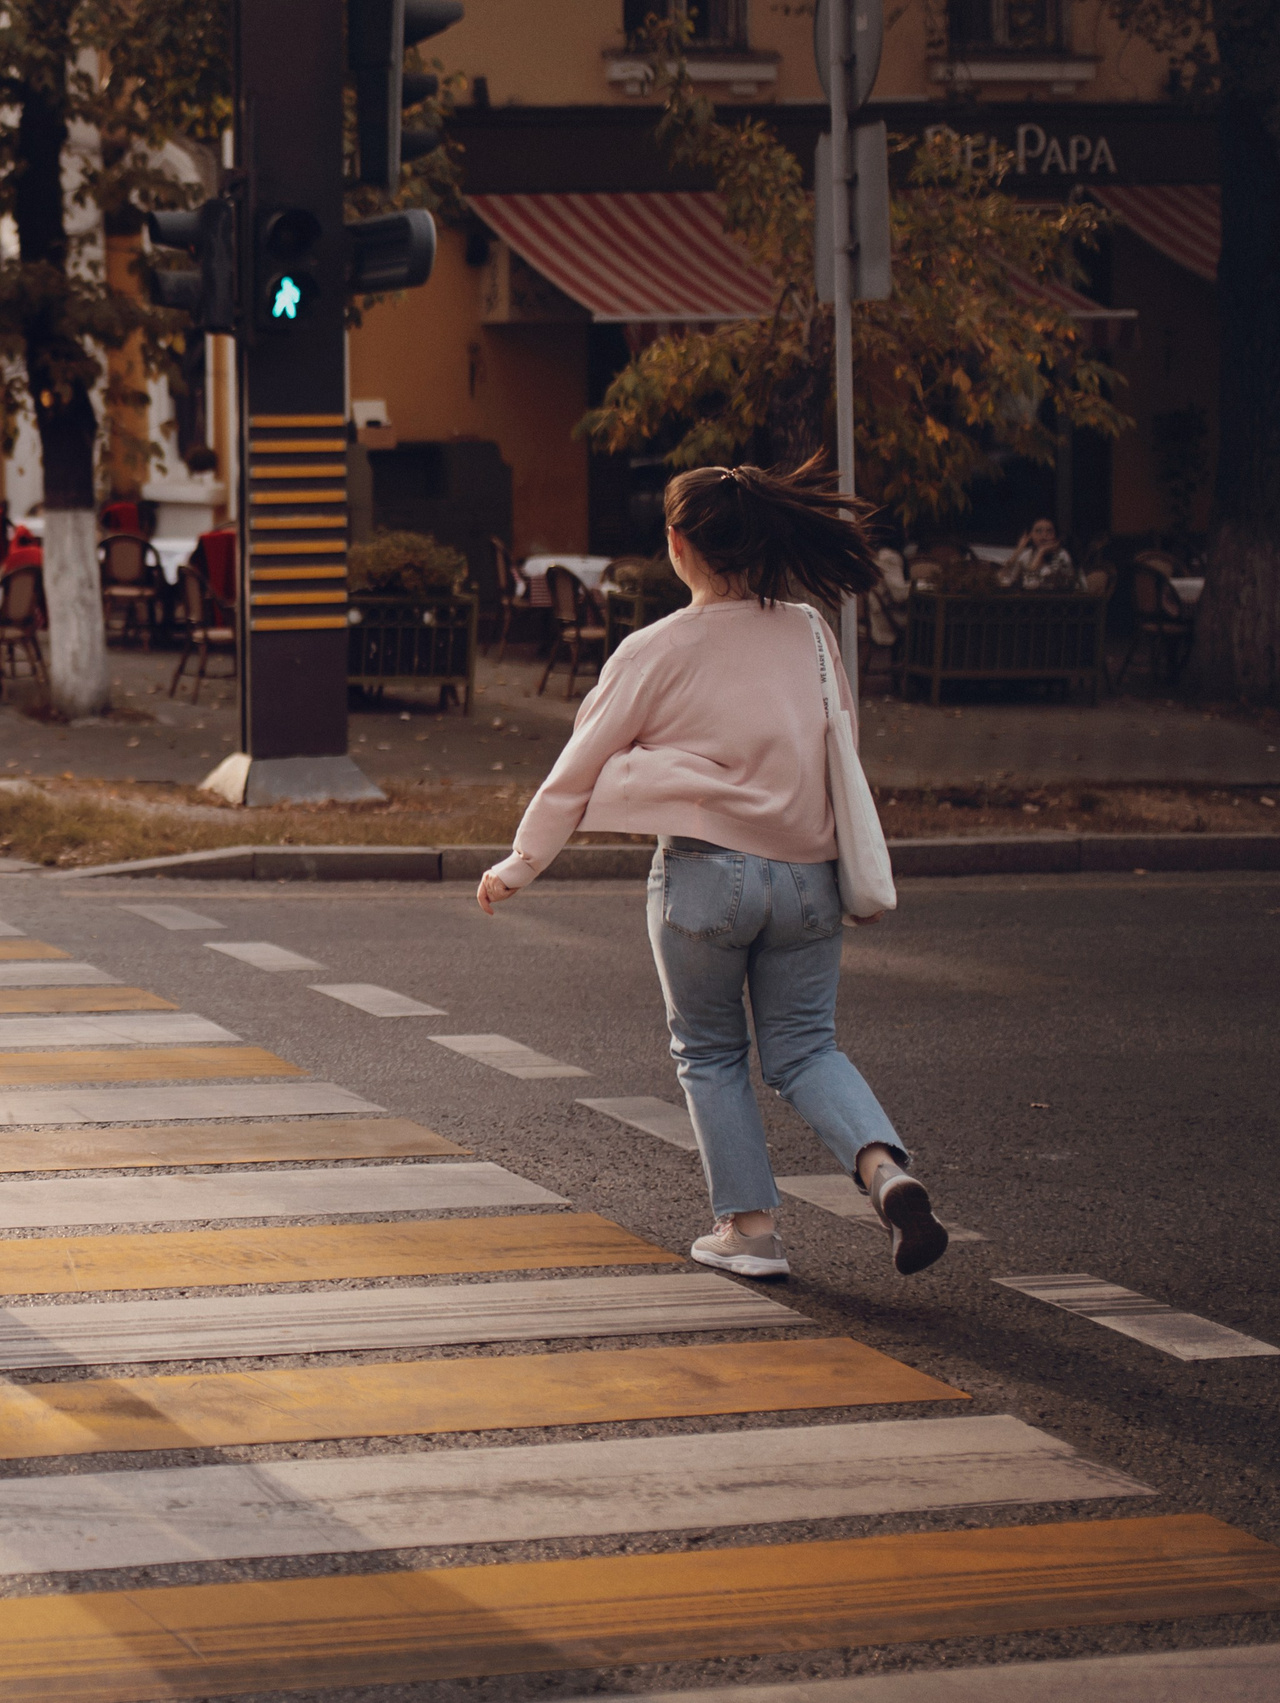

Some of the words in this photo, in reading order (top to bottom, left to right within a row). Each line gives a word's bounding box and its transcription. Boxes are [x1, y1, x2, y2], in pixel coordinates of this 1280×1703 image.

[1017, 123, 1117, 174] PAPA
[815, 631, 824, 652] BEARS
[820, 672, 827, 684] WE
